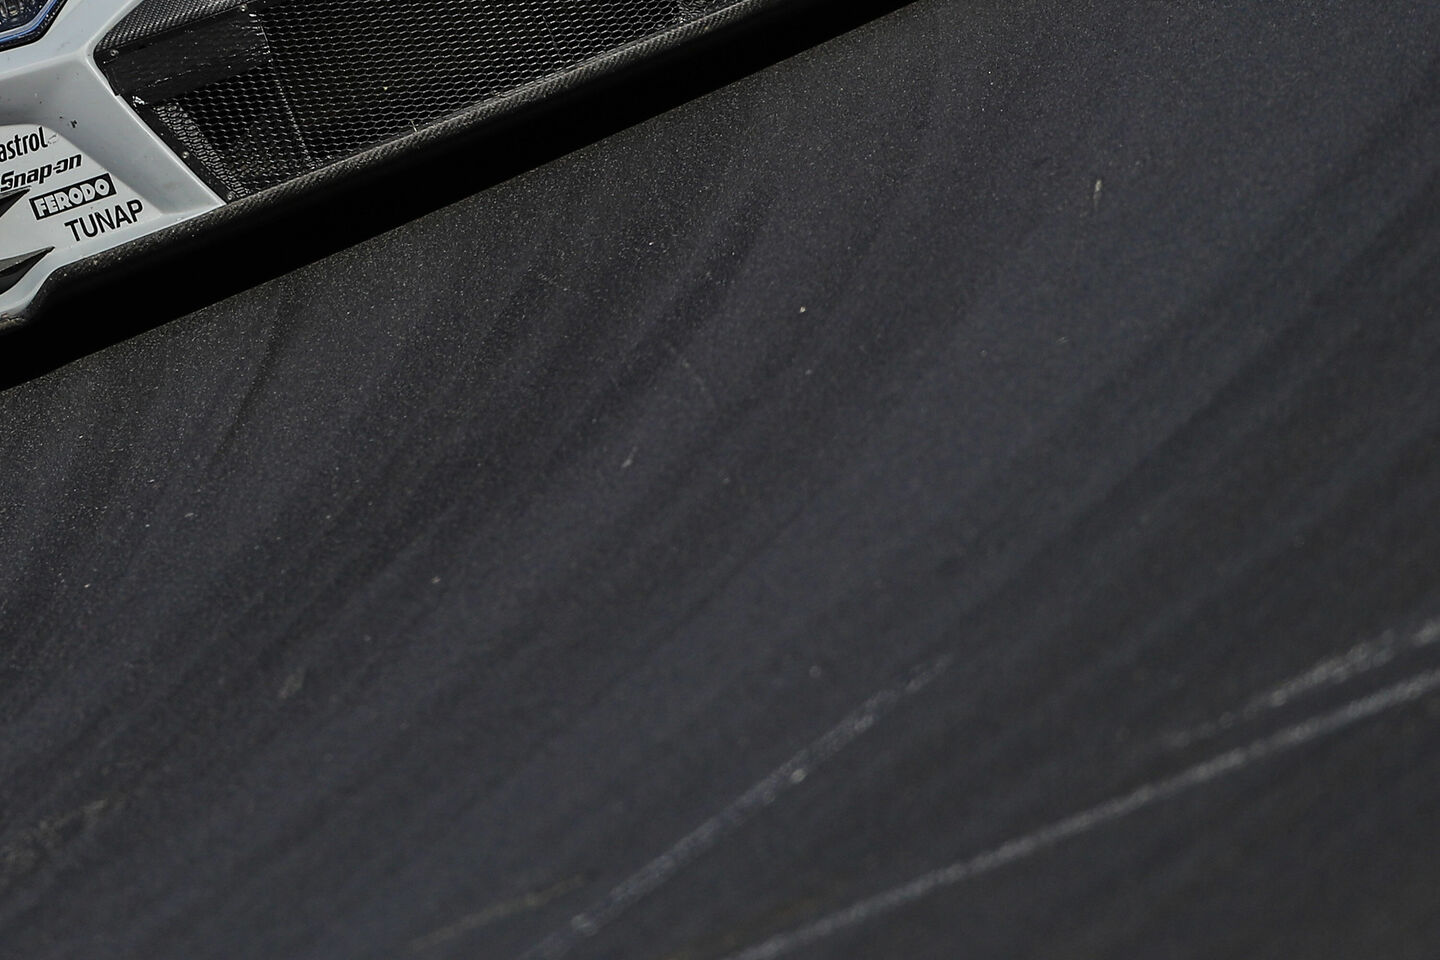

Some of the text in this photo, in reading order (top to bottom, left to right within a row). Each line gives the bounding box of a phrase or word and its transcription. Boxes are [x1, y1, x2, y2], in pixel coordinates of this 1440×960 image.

[0, 154, 82, 193] Snap-on
[36, 178, 110, 217] FERODO
[64, 199, 143, 242] TUNAP
